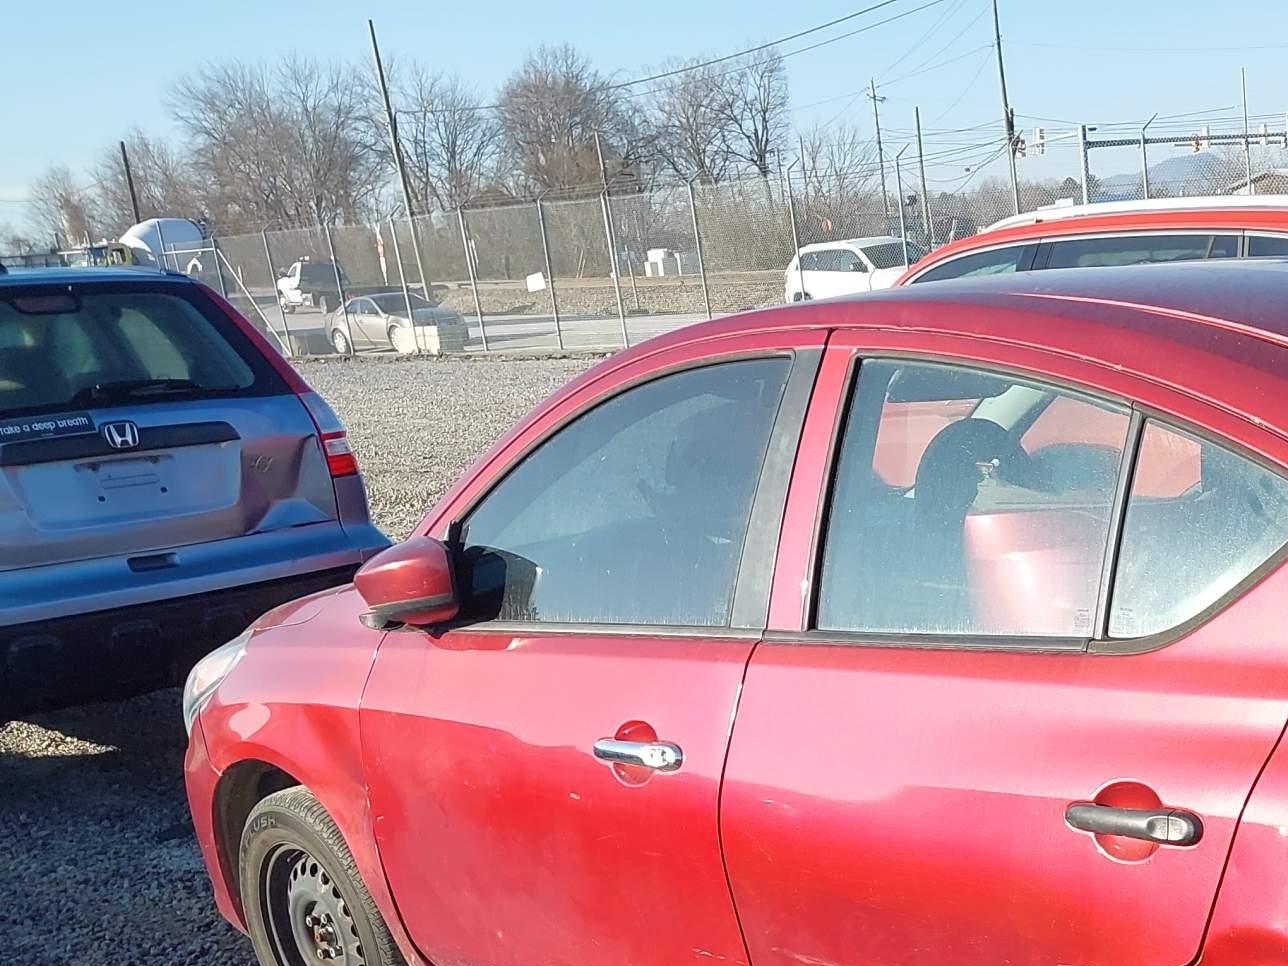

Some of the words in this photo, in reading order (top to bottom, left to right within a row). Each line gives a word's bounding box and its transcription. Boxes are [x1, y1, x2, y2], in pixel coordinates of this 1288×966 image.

[23, 424, 31, 432] a
[32, 421, 56, 431] deep
[57, 417, 89, 428] breath
